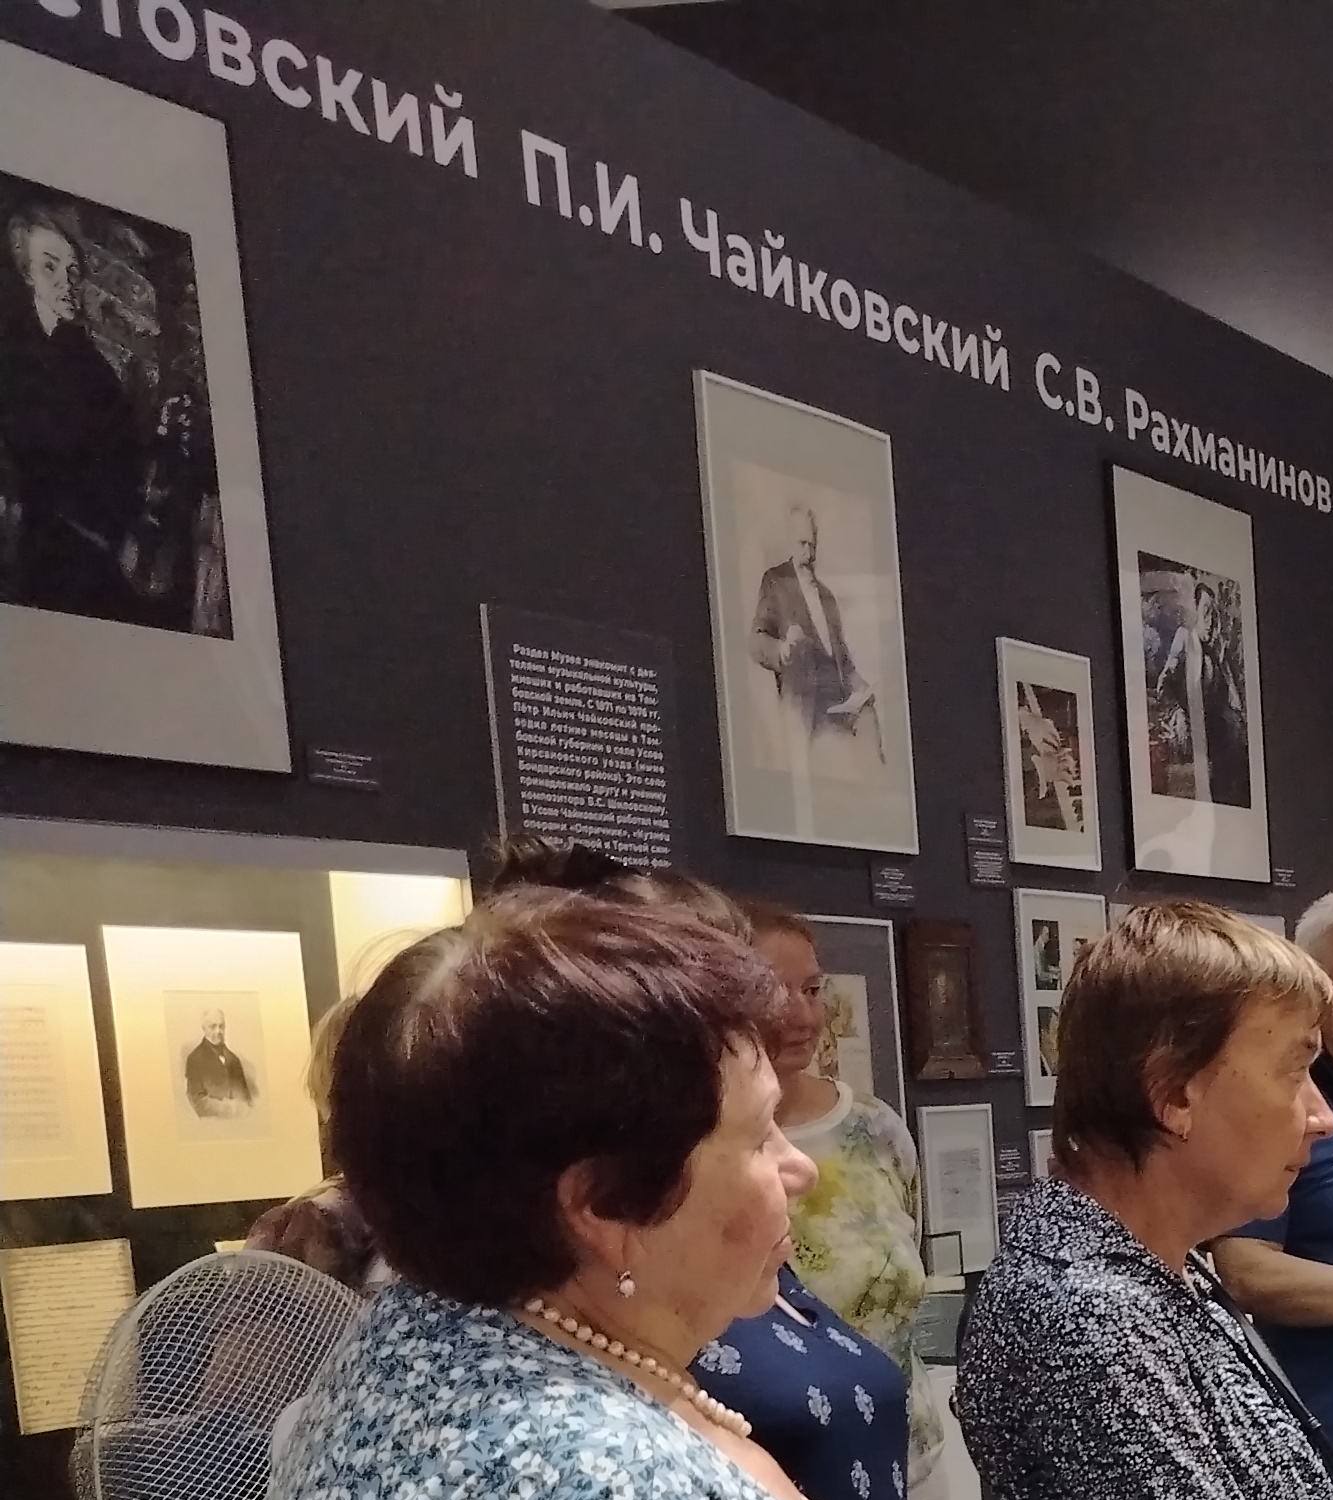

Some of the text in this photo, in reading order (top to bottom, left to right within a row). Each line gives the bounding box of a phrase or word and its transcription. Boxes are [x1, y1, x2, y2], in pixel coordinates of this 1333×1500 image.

[39, 0, 1332, 513] овский П.И. Чайковский С.В. Рахманинов
